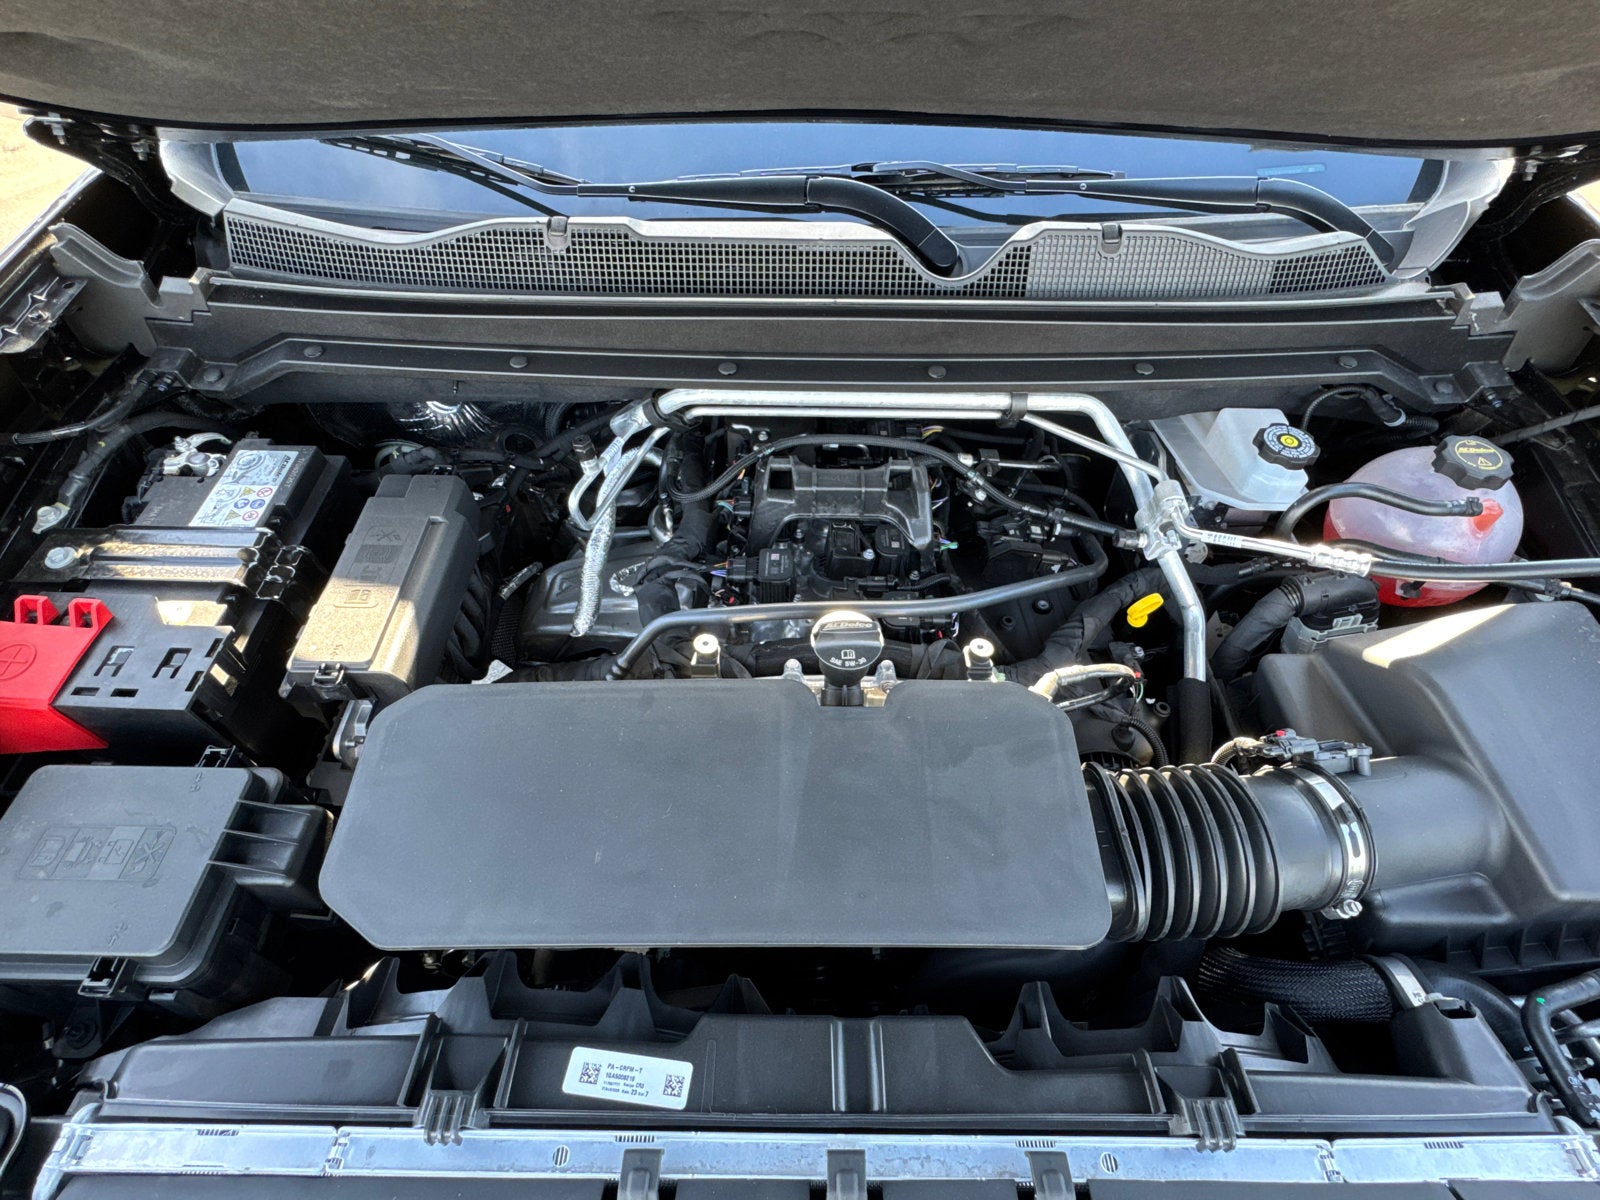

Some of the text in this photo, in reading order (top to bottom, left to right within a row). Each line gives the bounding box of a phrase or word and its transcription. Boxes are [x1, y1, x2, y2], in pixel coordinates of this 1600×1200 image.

[824, 621, 873, 629] ACDelco
[829, 657, 867, 667] SAE 5W-30
